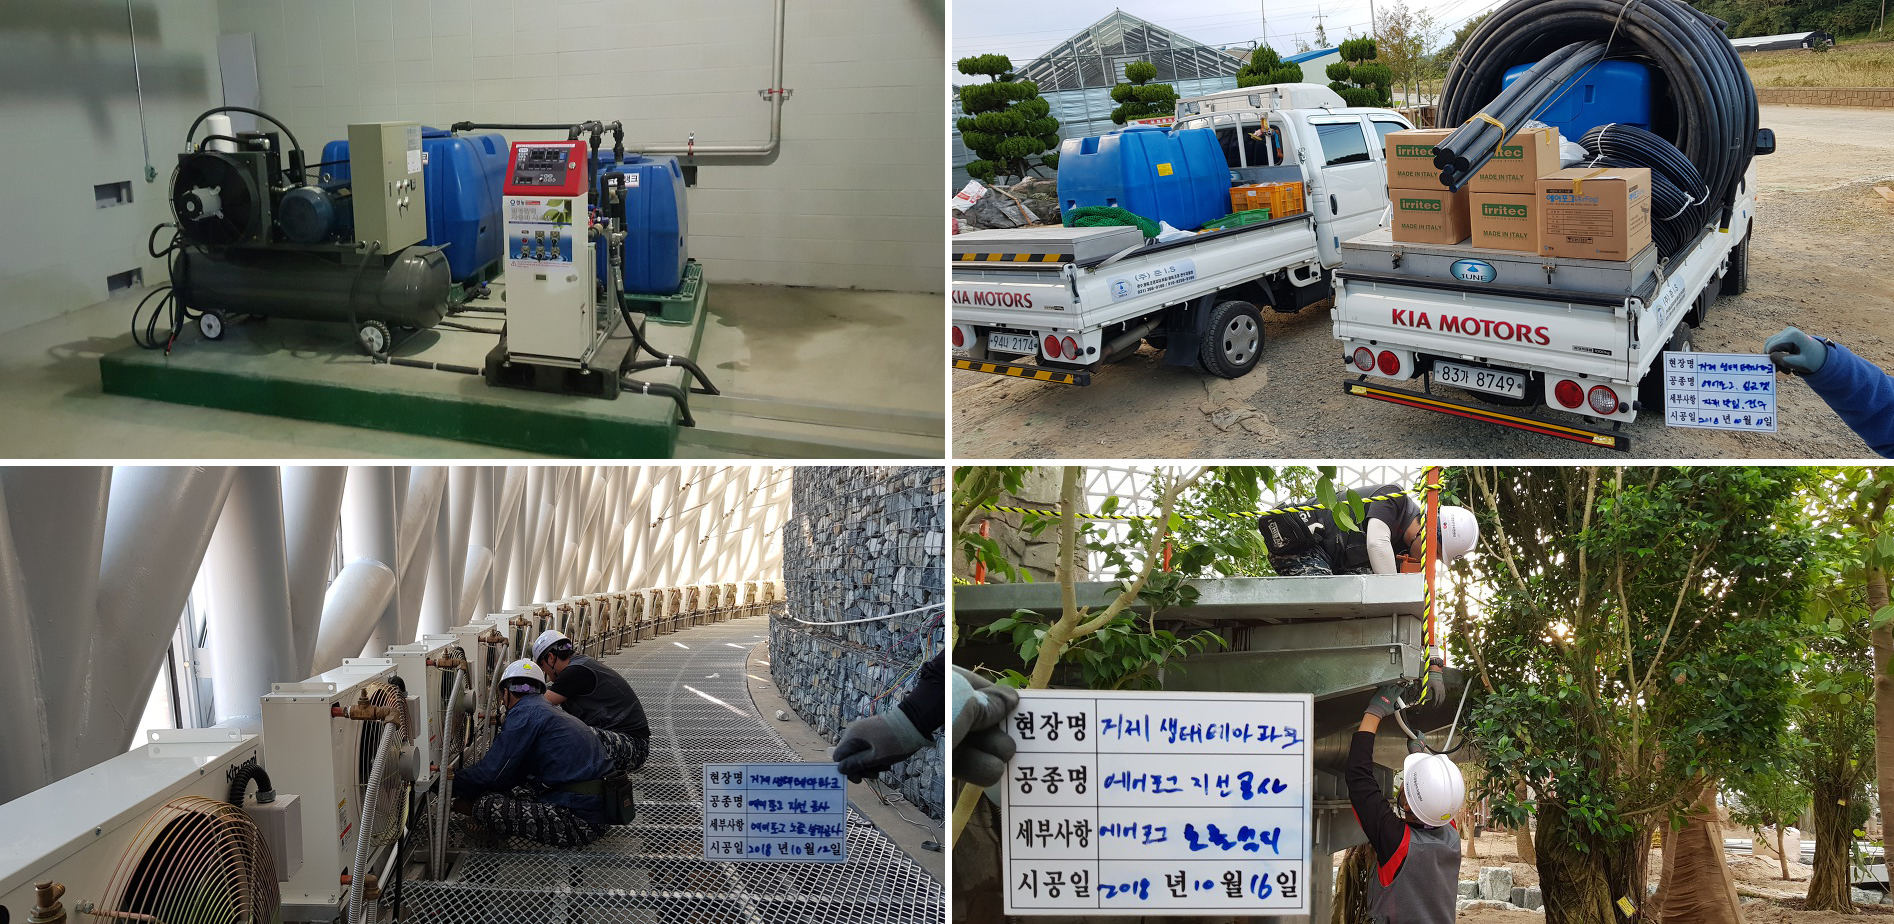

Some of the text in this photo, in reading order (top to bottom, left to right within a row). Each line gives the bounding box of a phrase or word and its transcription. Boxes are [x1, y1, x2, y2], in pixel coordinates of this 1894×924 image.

[1398, 146, 1434, 156] irritec
[1402, 200, 1440, 209] irritec
[1484, 205, 1525, 216] irritec
[1460, 273, 1488, 281] JUNE
[952, 290, 1033, 309] KIA MOTORS
[1392, 308, 1550, 346] KIA MOTORS
[1012, 337, 1034, 352] 2174
[1669, 358, 1694, 369] 현장명
[1442, 365, 1515, 393] 83가 8749
[1669, 376, 1694, 387] 공종명
[1670, 394, 1696, 404] 세부사항
[1670, 411, 1696, 422] 시공일
[1014, 712, 1086, 741] 현장명
[710, 771, 743, 785] 현장명
[1014, 765, 1087, 794] 공종명
[709, 795, 743, 808] 공종명
[709, 819, 744, 832] 세부사항
[1016, 819, 1092, 849] 세부사항
[710, 841, 743, 855] 시공일
[748, 843, 771, 857] 2018
[778, 842, 788, 855] 년
[804, 842, 815, 855] 월
[830, 842, 841, 855] 일
[1018, 870, 1090, 899] 시공일
[1097, 870, 1297, 900] 2018 년 10 월 16 일
